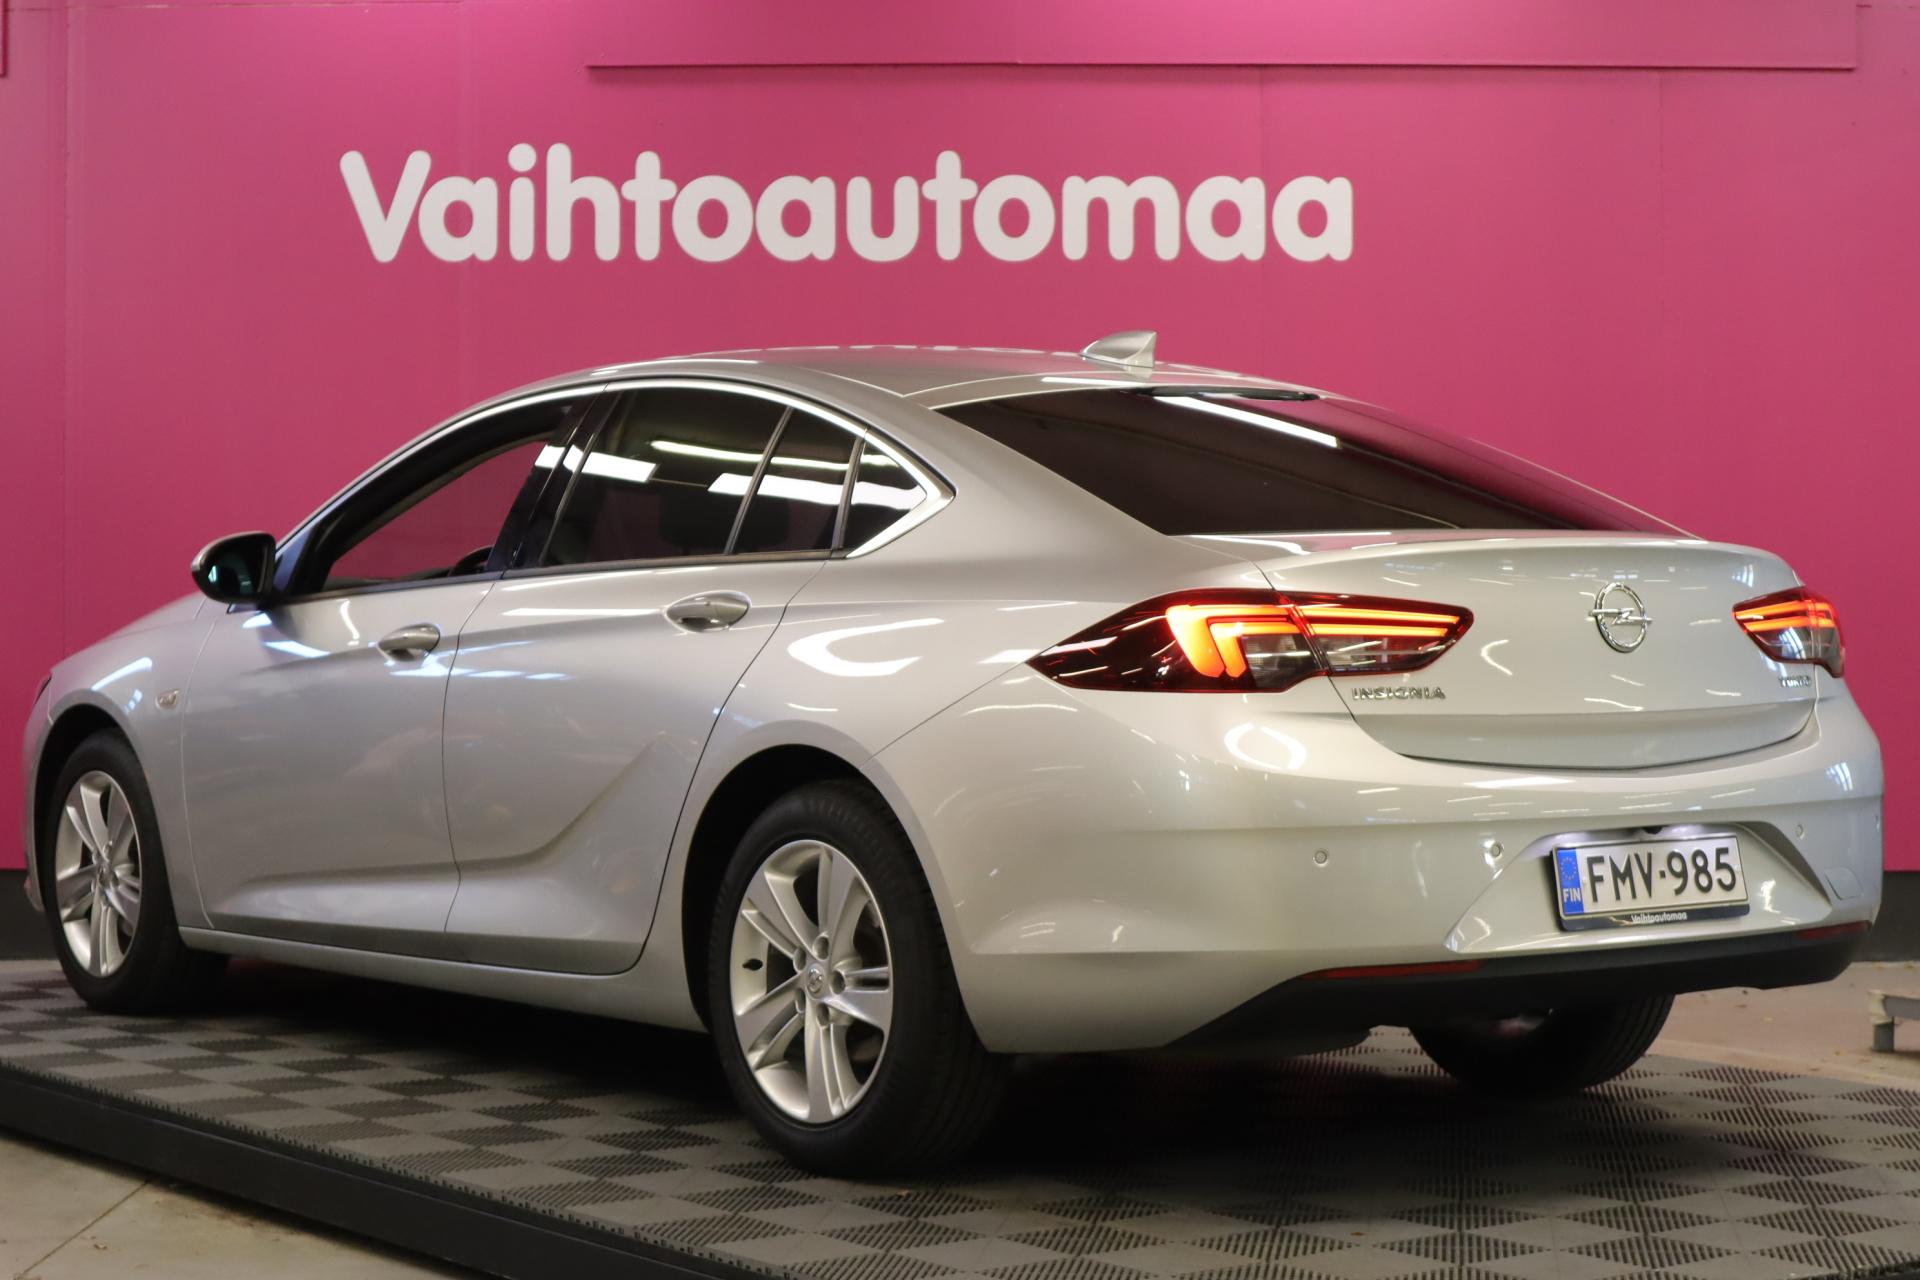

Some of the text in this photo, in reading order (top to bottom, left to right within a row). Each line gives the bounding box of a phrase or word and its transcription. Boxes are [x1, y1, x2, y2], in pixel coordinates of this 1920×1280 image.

[339, 143, 1353, 263] Vaihtoautomaa
[1352, 686, 1446, 701] INSIGNIA
[1563, 887, 1581, 903] FIN
